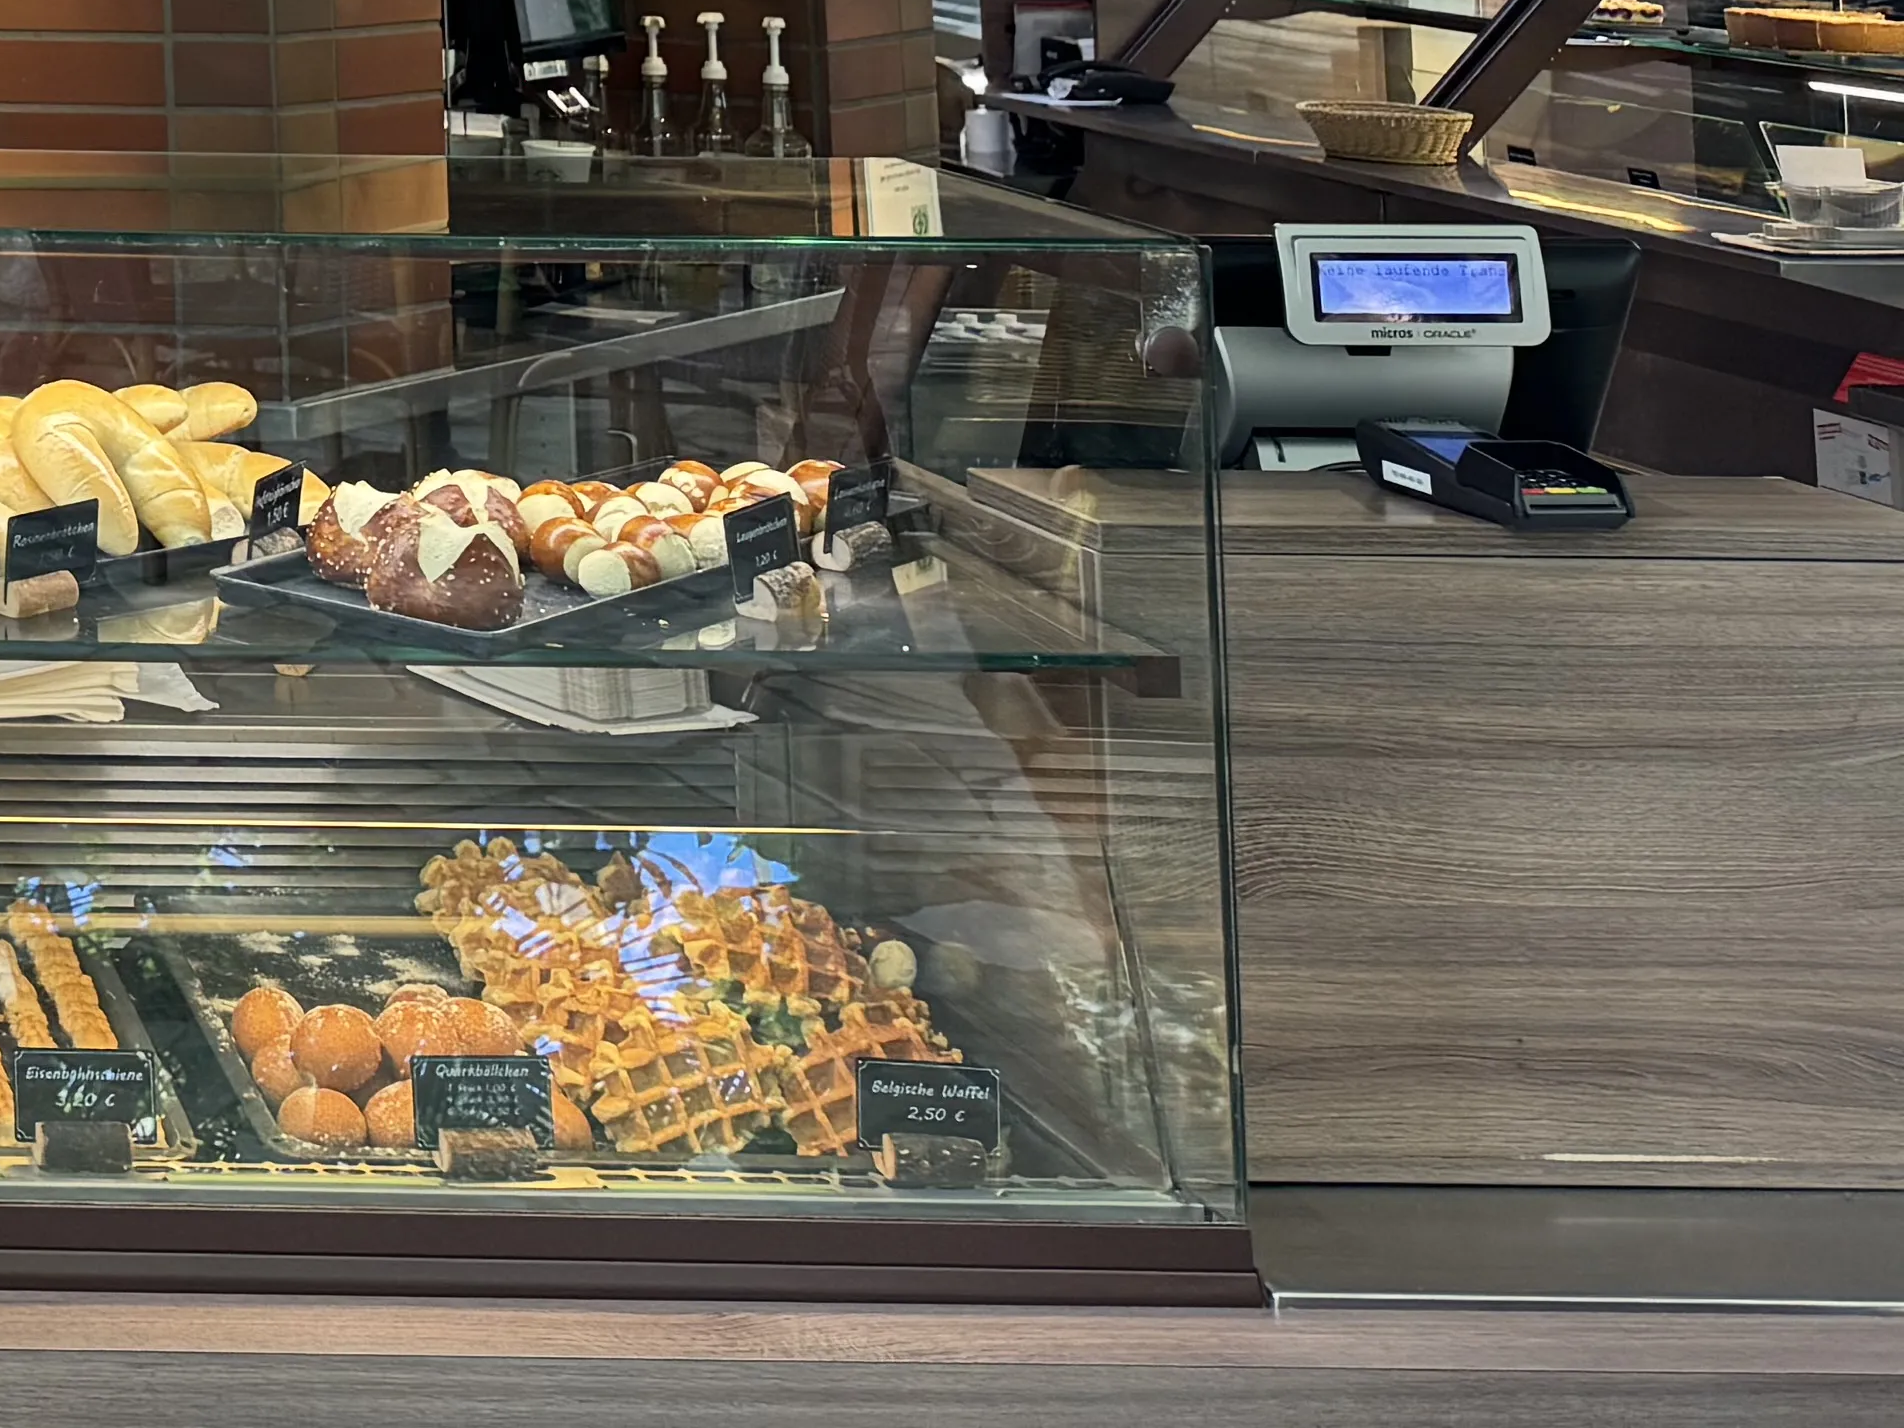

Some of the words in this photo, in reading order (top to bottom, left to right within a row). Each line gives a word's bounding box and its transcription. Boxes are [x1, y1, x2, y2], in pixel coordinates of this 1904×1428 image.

[1376, 264, 1449, 277] laufende
[1372, 327, 1413, 338] micros
[26, 1065, 143, 1081] Eisenbahnschiene
[435, 1064, 529, 1078] Quarkbällchen
[872, 1080, 934, 1097] Belgische
[942, 1085, 989, 1100] Waffel
